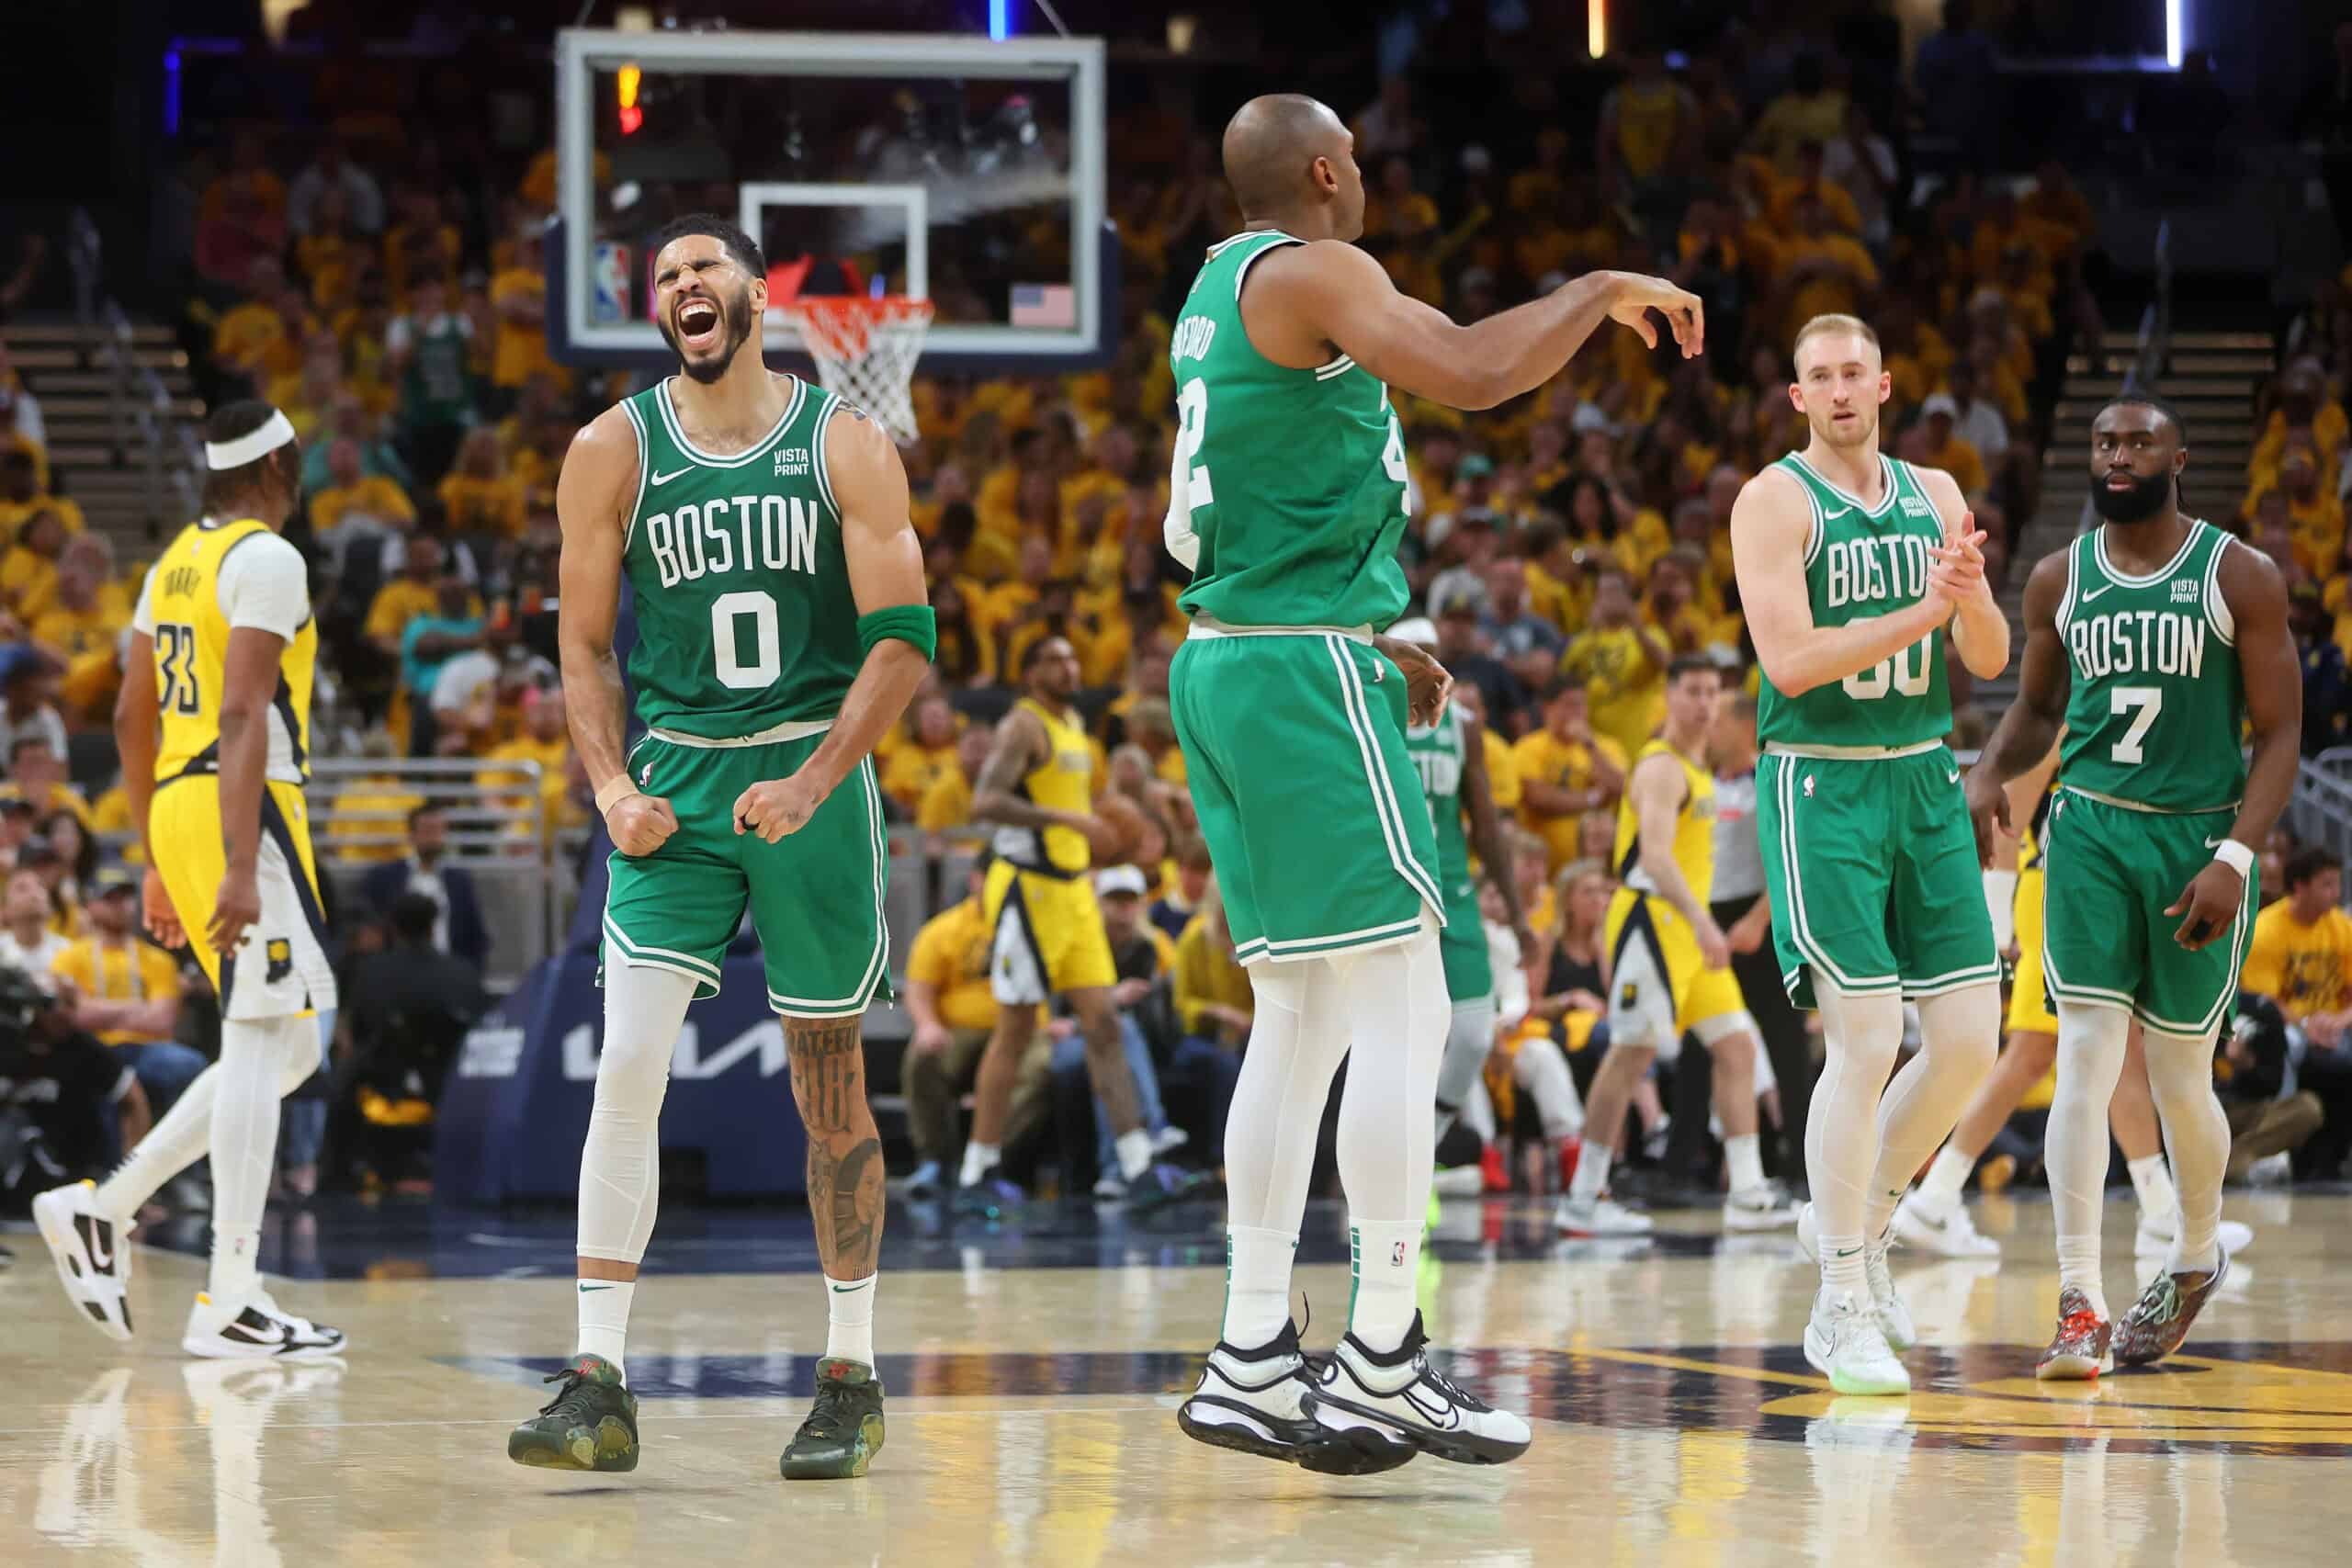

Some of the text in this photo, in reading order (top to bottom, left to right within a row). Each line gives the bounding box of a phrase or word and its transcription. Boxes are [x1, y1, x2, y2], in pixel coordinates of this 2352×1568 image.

[774, 448, 808, 466] VISTA
[774, 463, 808, 477] PRINT
[646, 495, 818, 589] BOSTON
[2170, 592, 2199, 604] PRINT
[2171, 580, 2199, 593] VISTA
[154, 623, 200, 715] 33
[711, 591, 781, 689] 0
[2071, 610, 2205, 681] BOSTON
[2110, 686, 2162, 764] 7
